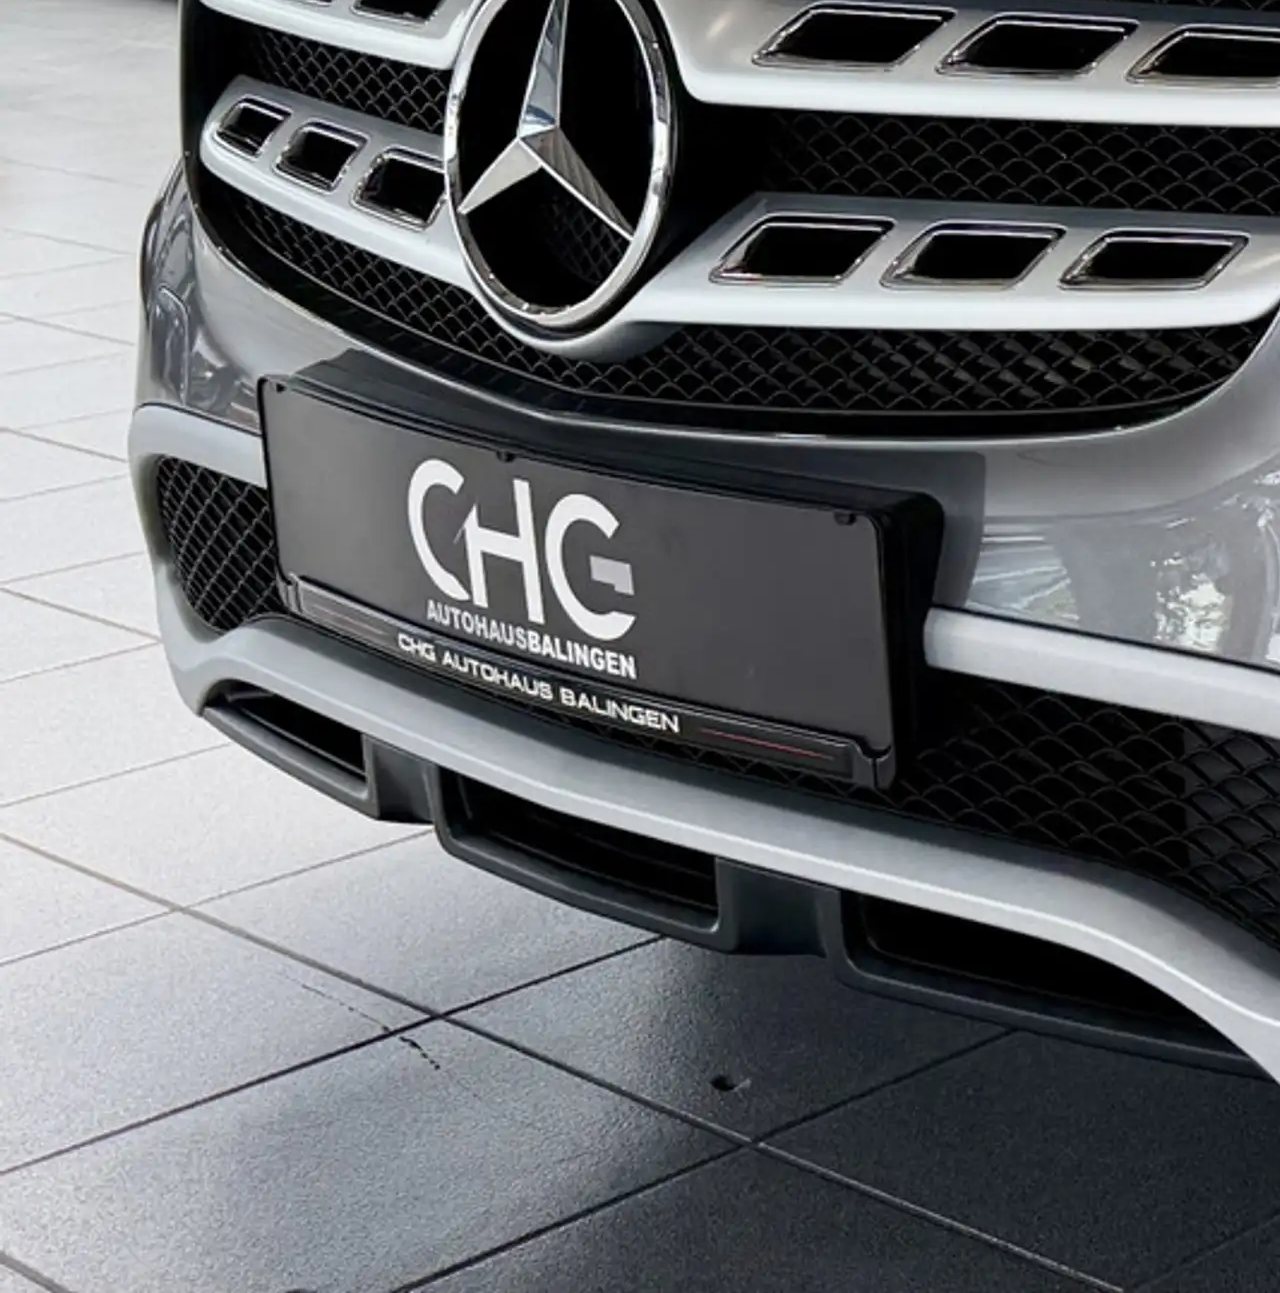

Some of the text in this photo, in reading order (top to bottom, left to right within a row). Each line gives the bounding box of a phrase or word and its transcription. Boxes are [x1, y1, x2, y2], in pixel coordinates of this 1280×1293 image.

[407, 458, 637, 641] CHG
[398, 632, 680, 733] CHG AUTOHAUS BALINGEN
